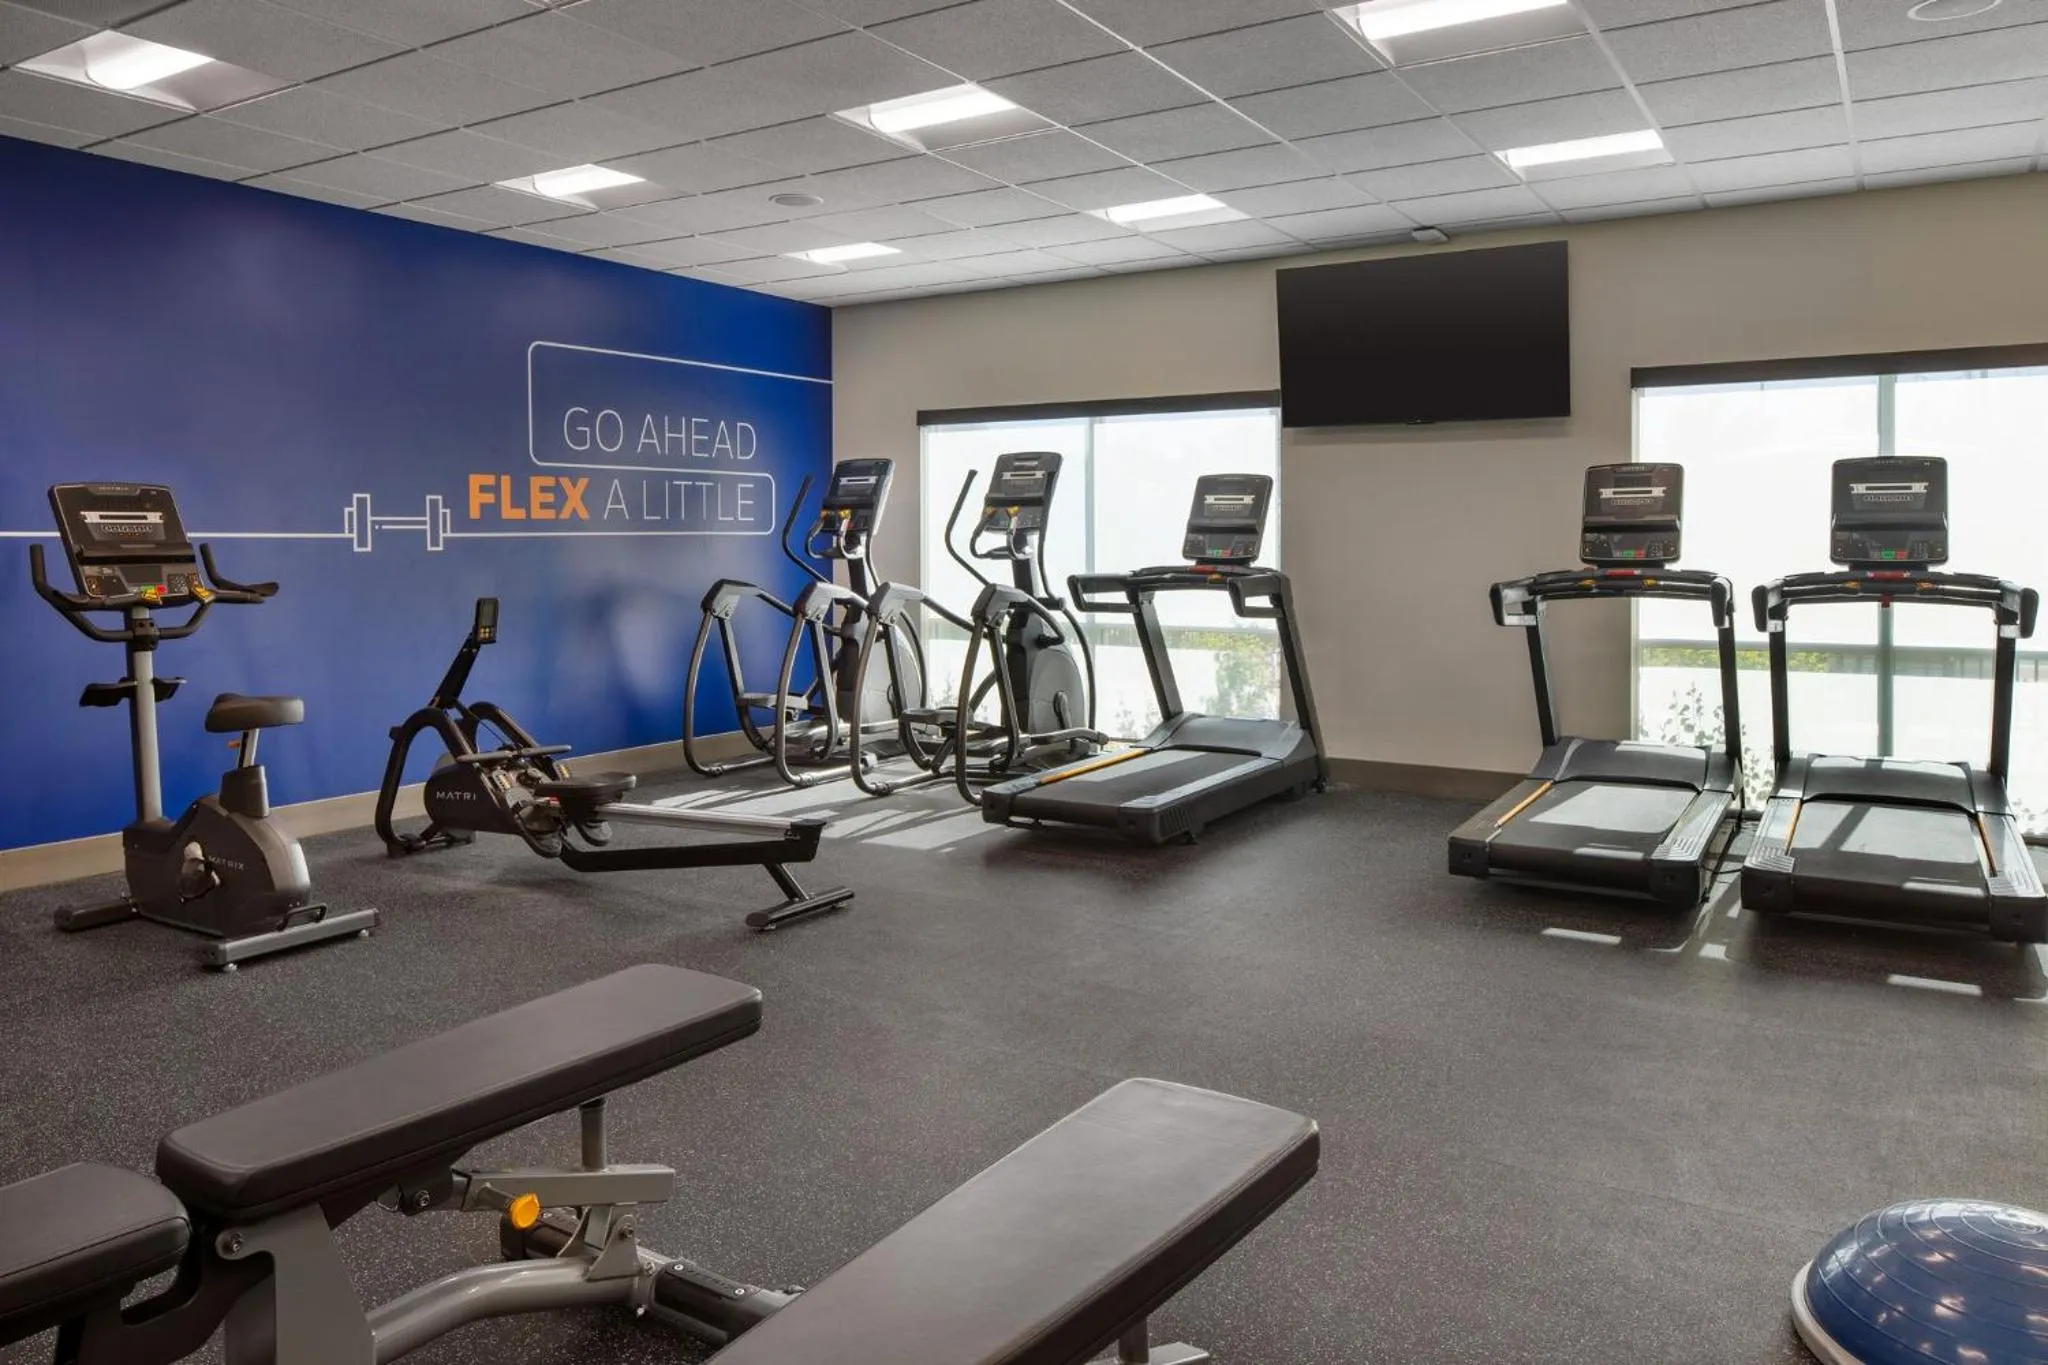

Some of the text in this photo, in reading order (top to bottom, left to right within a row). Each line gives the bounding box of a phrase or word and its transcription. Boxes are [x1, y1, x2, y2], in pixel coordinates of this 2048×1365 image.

[563, 407, 757, 461] GO AHEAD
[468, 473, 755, 521] FLEX A LITTLE
